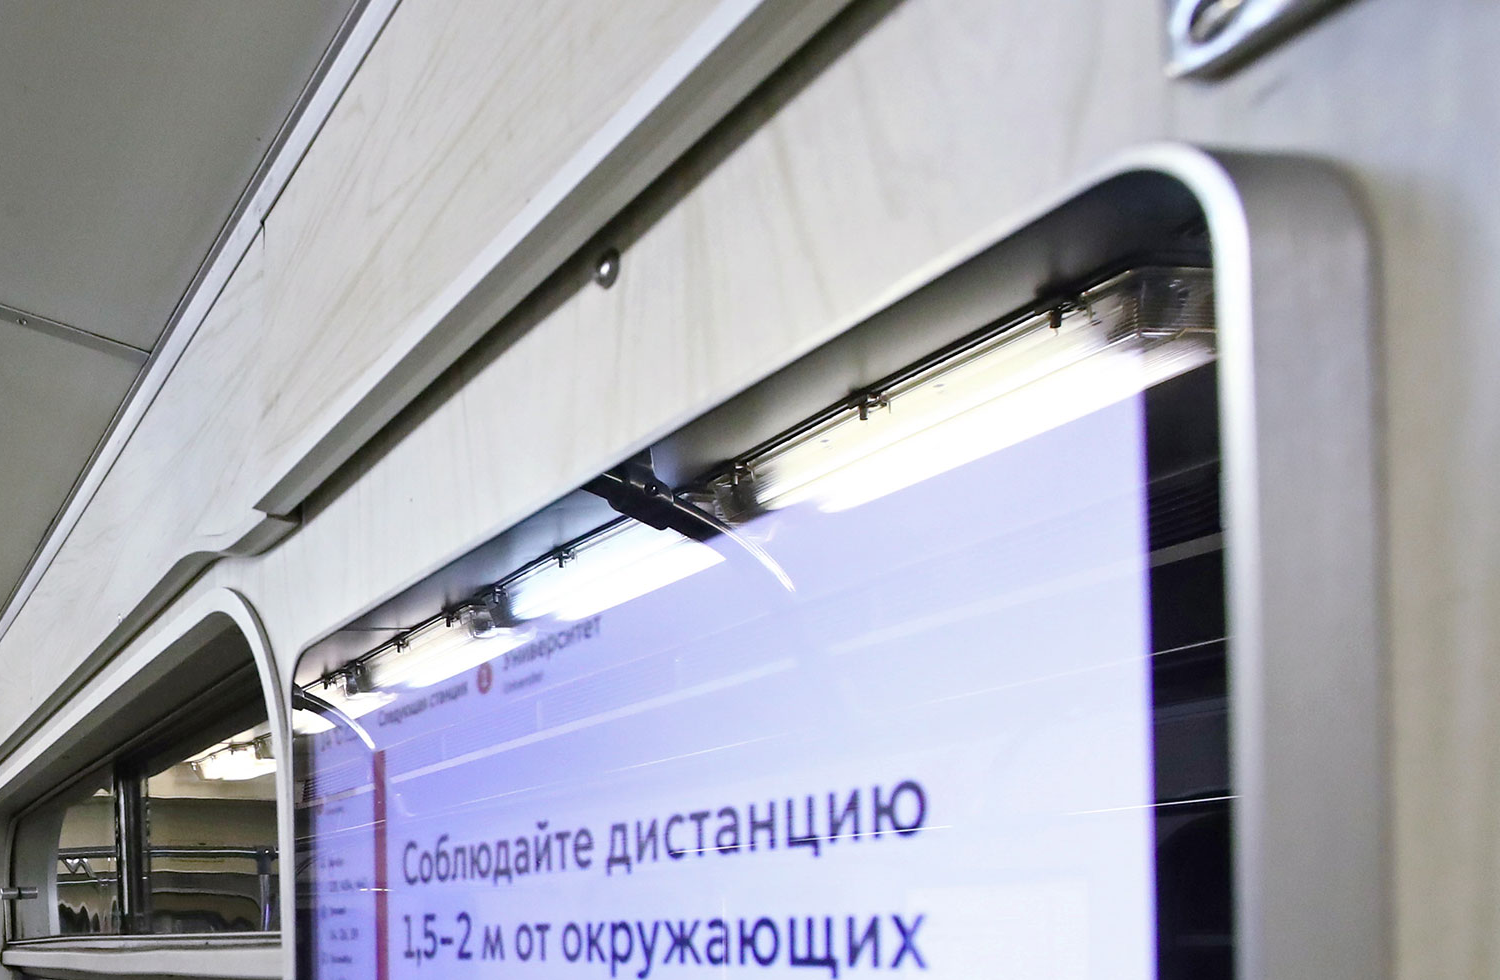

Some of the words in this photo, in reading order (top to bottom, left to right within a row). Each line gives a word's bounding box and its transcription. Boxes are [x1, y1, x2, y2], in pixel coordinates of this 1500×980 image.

[403, 820, 594, 886] Соблюдайте
[606, 779, 928, 876] дистанцию
[481, 924, 504, 961] м
[514, 922, 551, 963] от
[563, 915, 929, 980] окружающих
